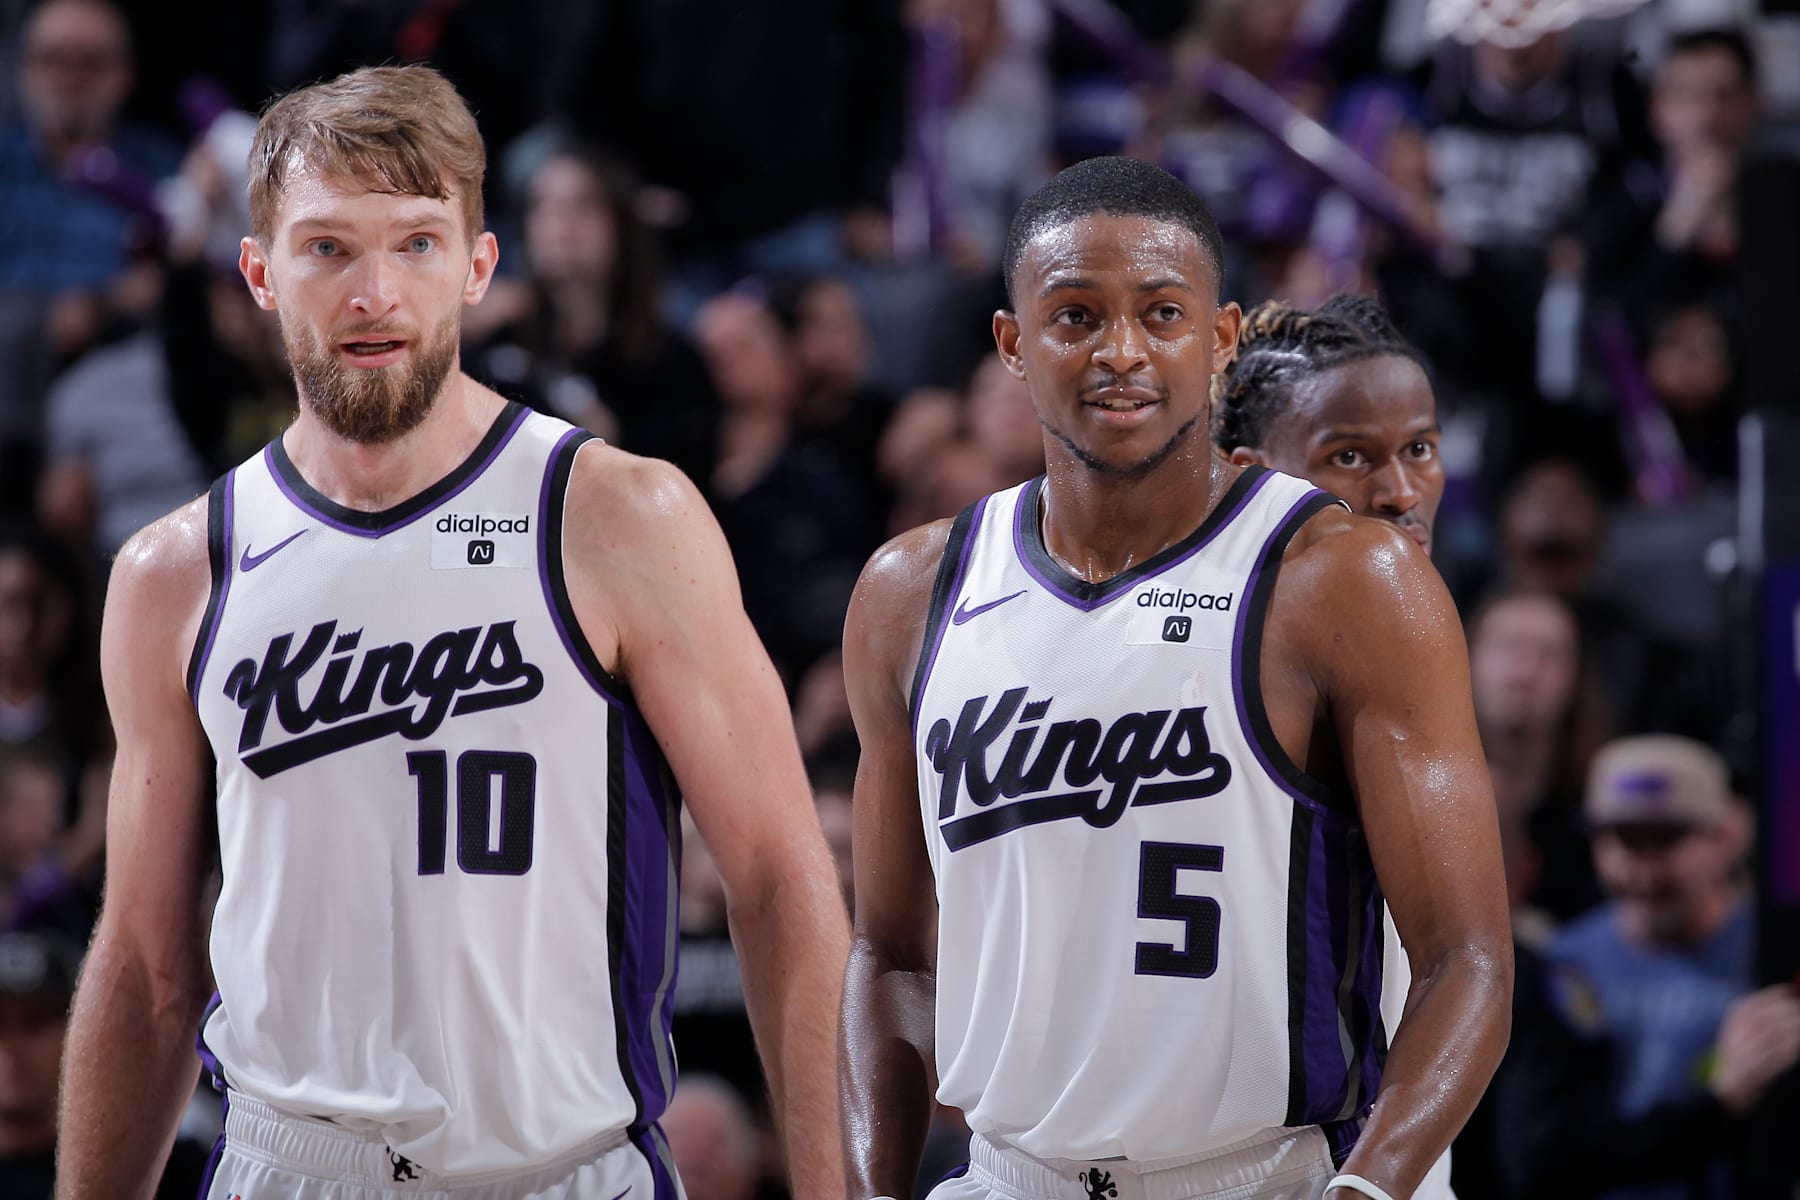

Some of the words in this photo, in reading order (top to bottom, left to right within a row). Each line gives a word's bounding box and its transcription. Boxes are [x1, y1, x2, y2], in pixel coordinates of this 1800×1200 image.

[436, 514, 530, 537] dialpad
[1137, 588, 1233, 613] dialpad
[223, 619, 544, 779] Kings
[406, 750, 536, 875] 10
[926, 687, 1232, 852] Kings
[1135, 841, 1225, 979] 5
